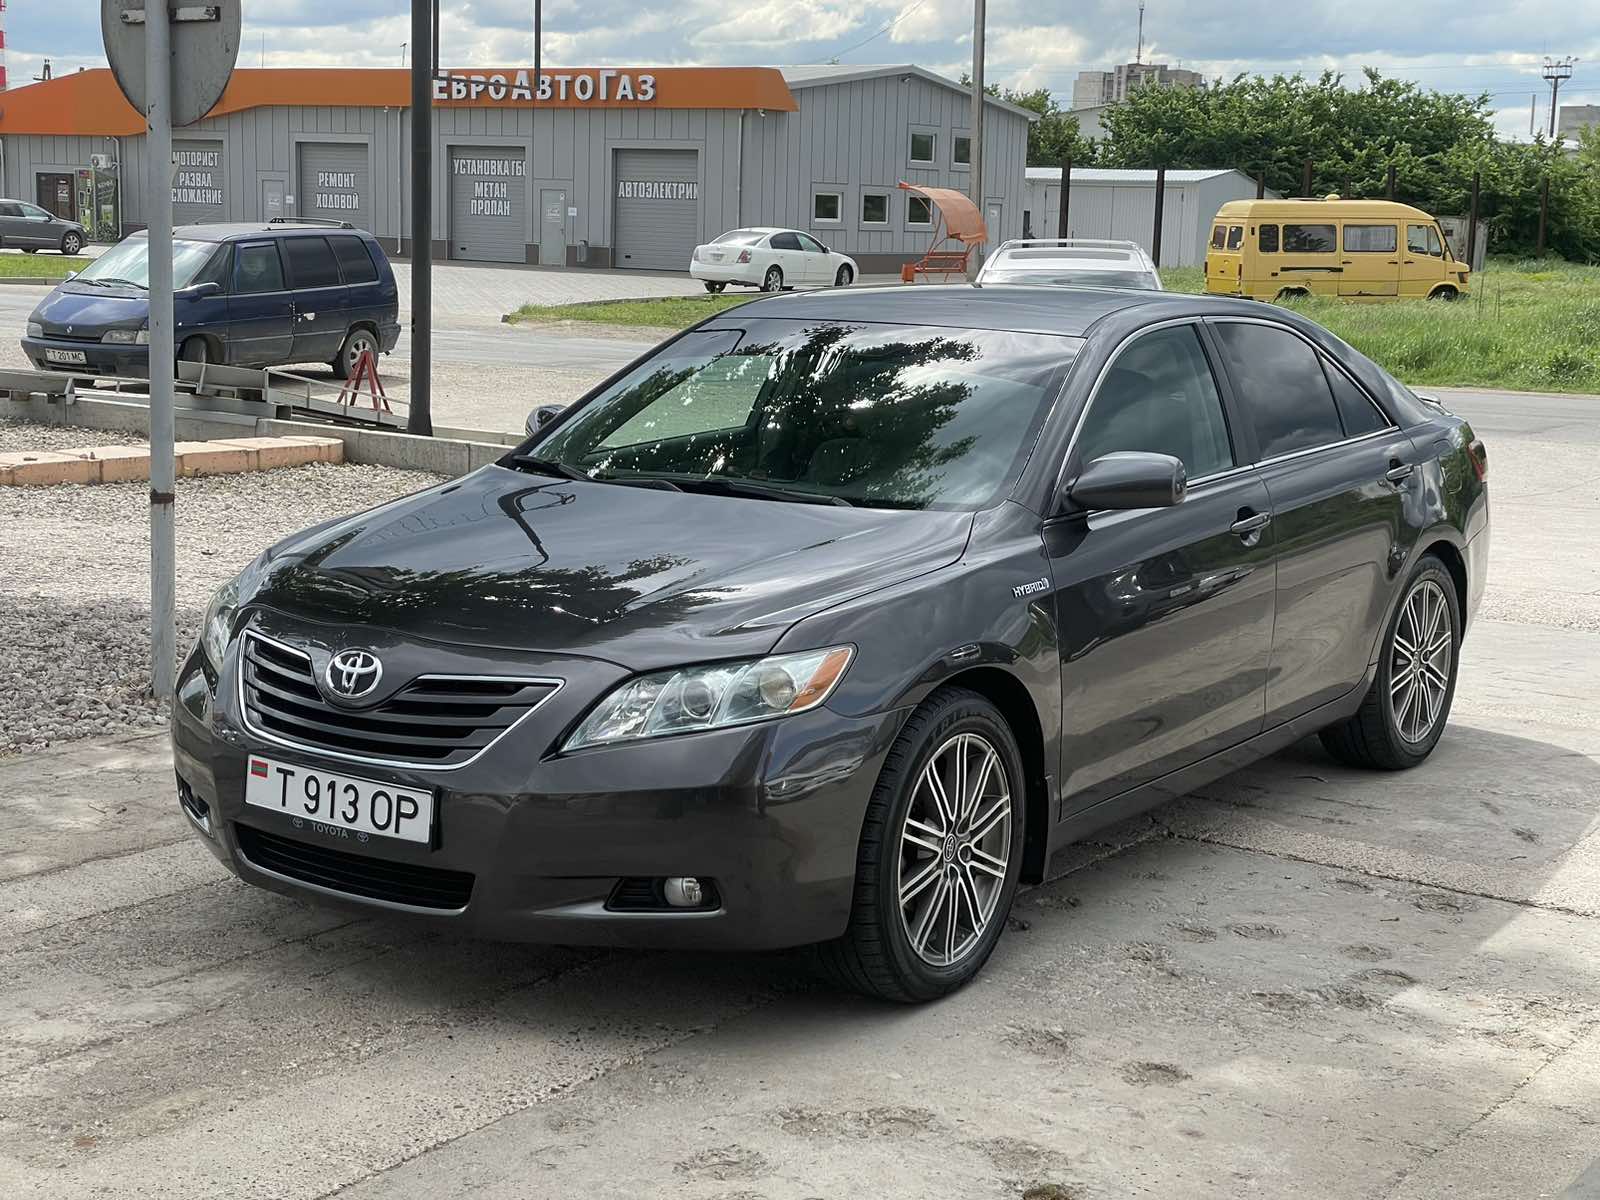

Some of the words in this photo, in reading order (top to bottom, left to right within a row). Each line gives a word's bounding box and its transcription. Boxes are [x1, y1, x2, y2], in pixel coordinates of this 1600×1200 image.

[453, 159, 510, 176] УСТАНОВКА
[179, 172, 212, 187] РАЗВАЛ
[318, 172, 355, 188] РЕМОНТ
[171, 188, 222, 204] СХОЖДЕНИЕ
[474, 182, 507, 198] МЕТАН
[316, 192, 359, 209] ХОДОВОЙ
[470, 199, 511, 216] ПРОПАН
[57, 351, 72, 361] 201
[1012, 580, 1046, 598] HYBRID
[276, 767, 295, 808] T
[303, 775, 360, 824] 913
[370, 790, 419, 834] OP
[311, 822, 349, 839] TOYOTA
